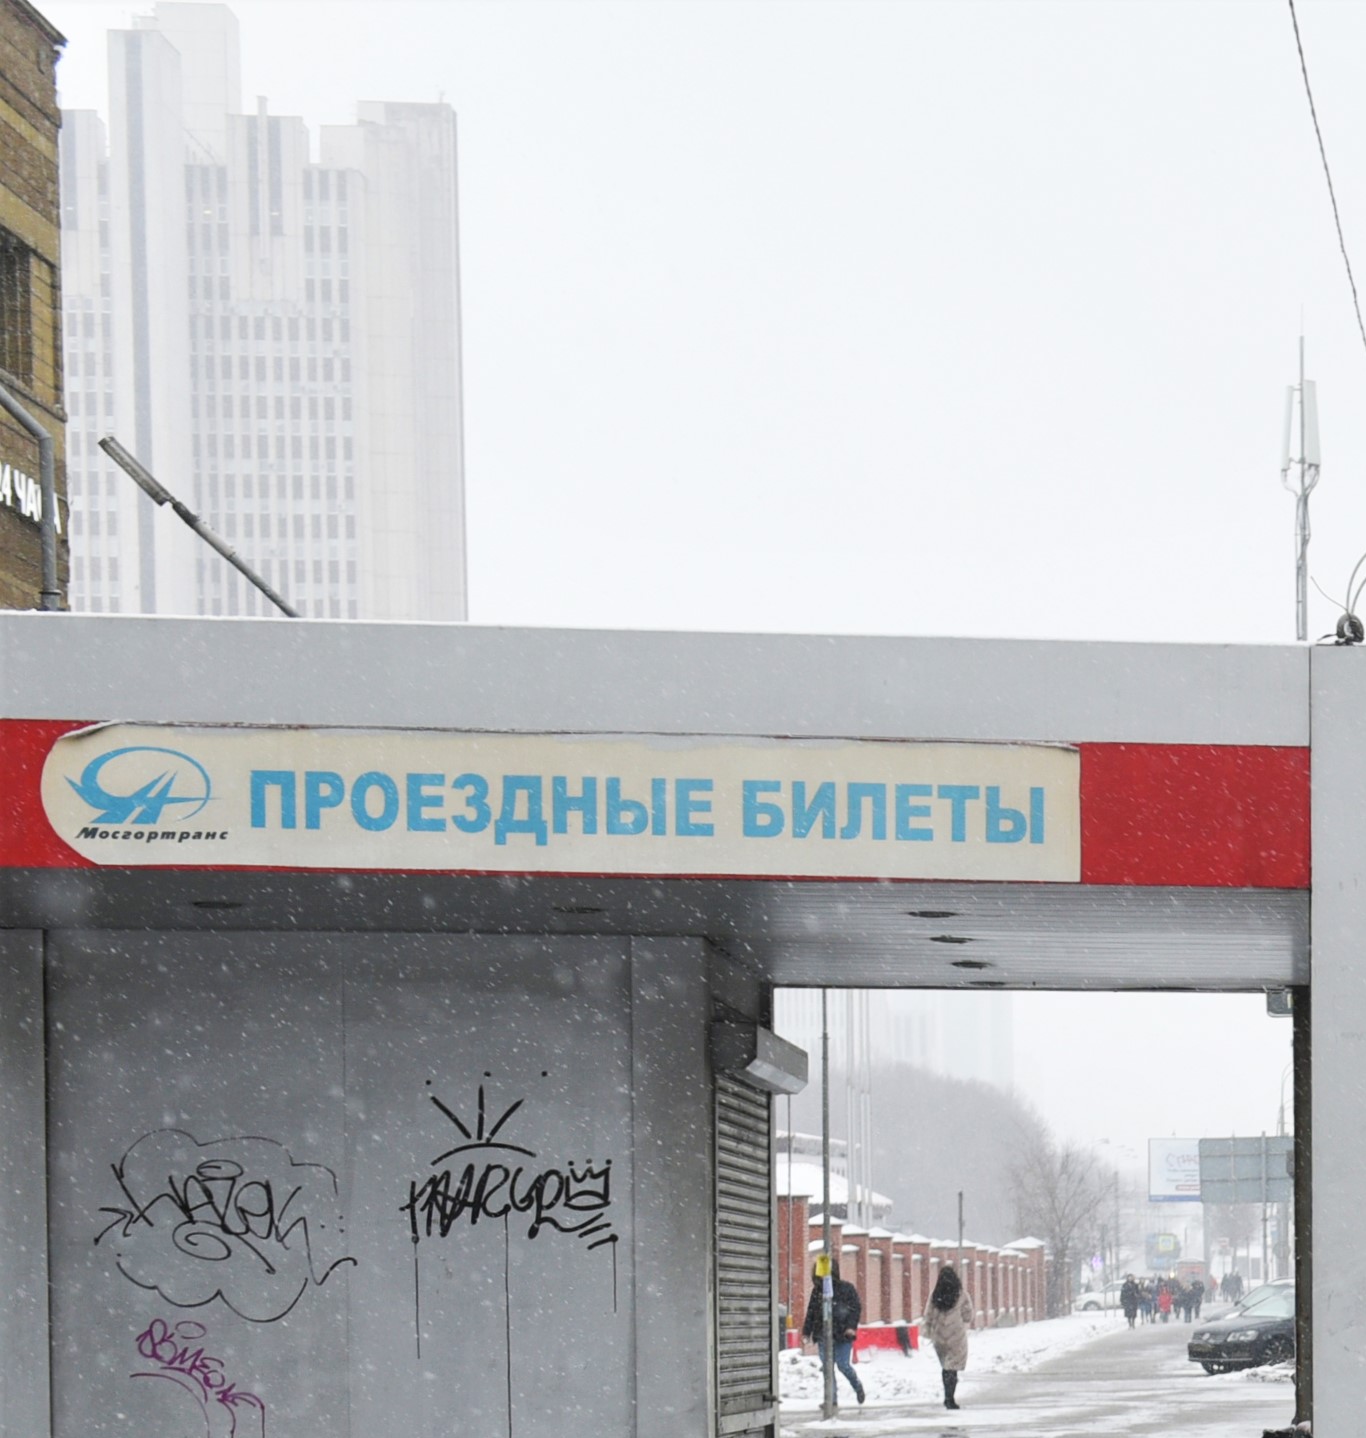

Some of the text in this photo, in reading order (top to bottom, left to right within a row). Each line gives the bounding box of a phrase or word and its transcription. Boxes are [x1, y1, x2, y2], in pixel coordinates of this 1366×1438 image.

[0, 461, 12, 506] 4
[249, 769, 1045, 847] ПРОЕЗДНЫЕ БИЛЕТЫ
[75, 826, 229, 844] Мосгортранс
